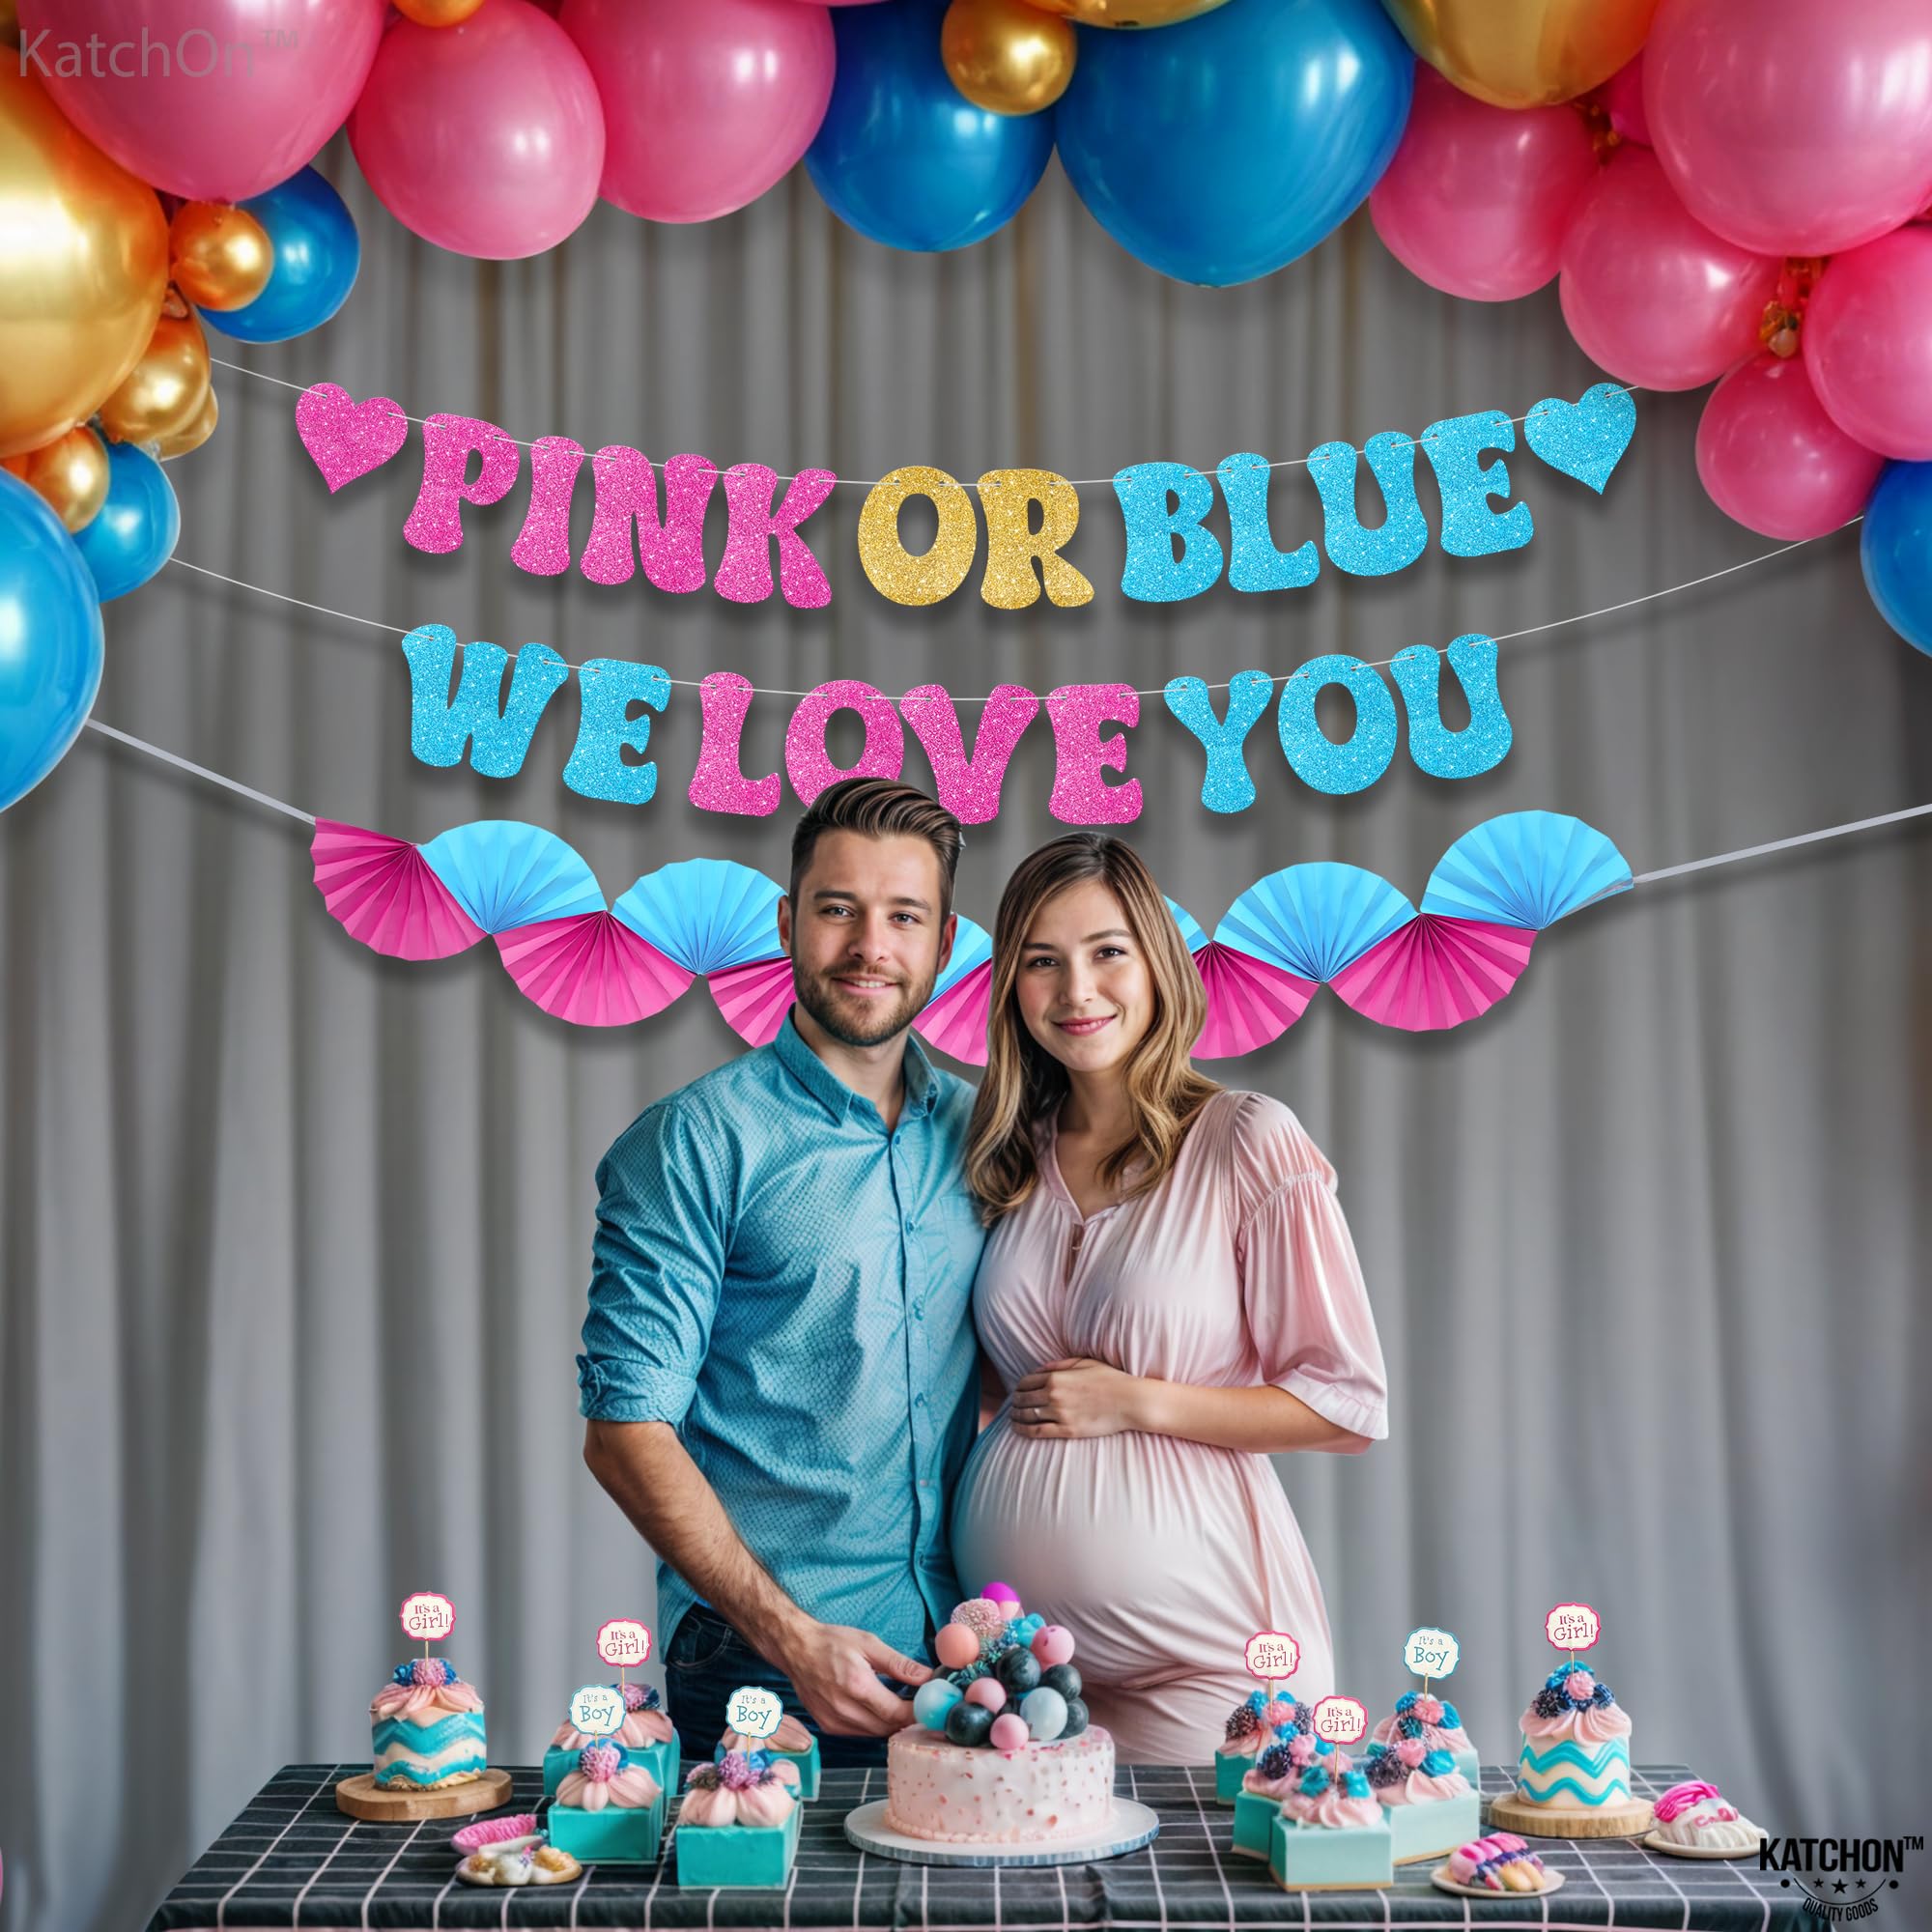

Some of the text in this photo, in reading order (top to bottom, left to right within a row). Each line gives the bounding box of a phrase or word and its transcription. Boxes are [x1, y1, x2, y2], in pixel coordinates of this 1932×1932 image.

[403, 410, 1534, 610] PINK OR BLUE
[402, 623, 1513, 825] WE LOVE YOU
[433, 1605, 440, 1613] a
[1577, 1614, 1584, 1623] a
[409, 1612, 449, 1631] Girl!
[629, 1631, 636, 1639] a
[1553, 1622, 1594, 1641] Girl!
[605, 1638, 645, 1657] Girl!
[1276, 1643, 1284, 1652] a
[1253, 1650, 1293, 1669] Girl!
[1413, 1645, 1450, 1671] Boy
[580, 1705, 615, 1727] Boy
[736, 1705, 773, 1730] Boy
[1345, 1708, 1352, 1717] a
[1321, 1716, 1361, 1733] Girl!
